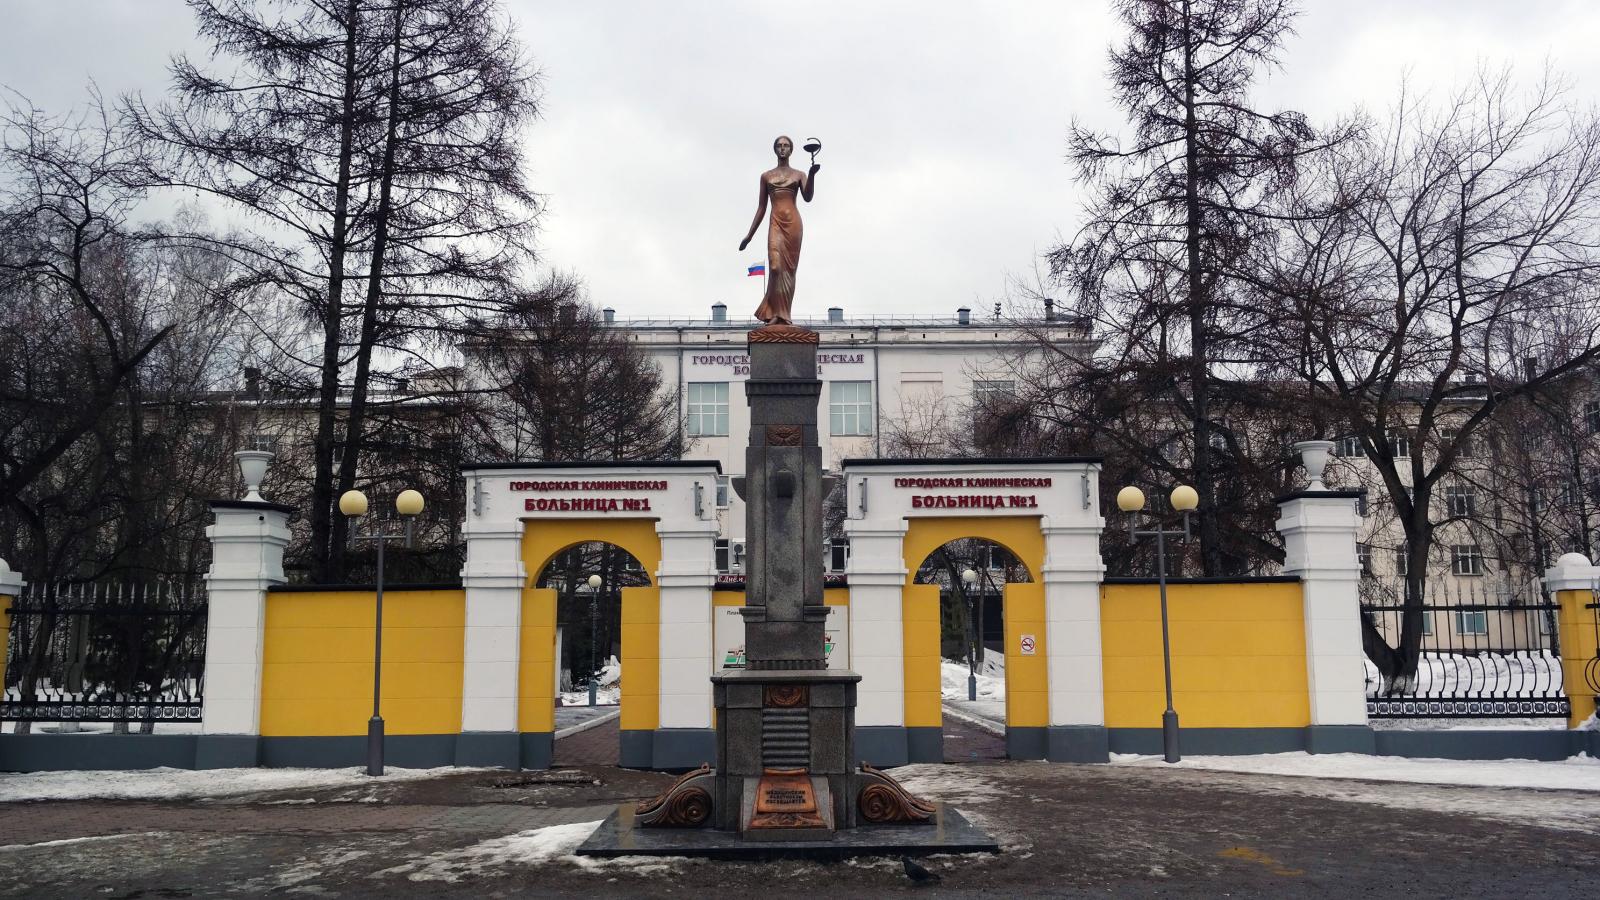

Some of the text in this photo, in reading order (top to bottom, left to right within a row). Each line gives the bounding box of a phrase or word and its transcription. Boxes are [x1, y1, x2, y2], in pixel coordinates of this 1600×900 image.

[692, 355, 750, 366] ГОРОДСК
[509, 480, 668, 492] ГОРОДСКАЯ КЛИНИЧЕСКАЯ
[894, 478, 1052, 489] ГОРОДСКАЯ КЛИНИЧЕСКАЯ
[524, 498, 651, 513] БОЛЬНИЦА №1
[912, 495, 1038, 510] БОЛЬНИЦА №1
